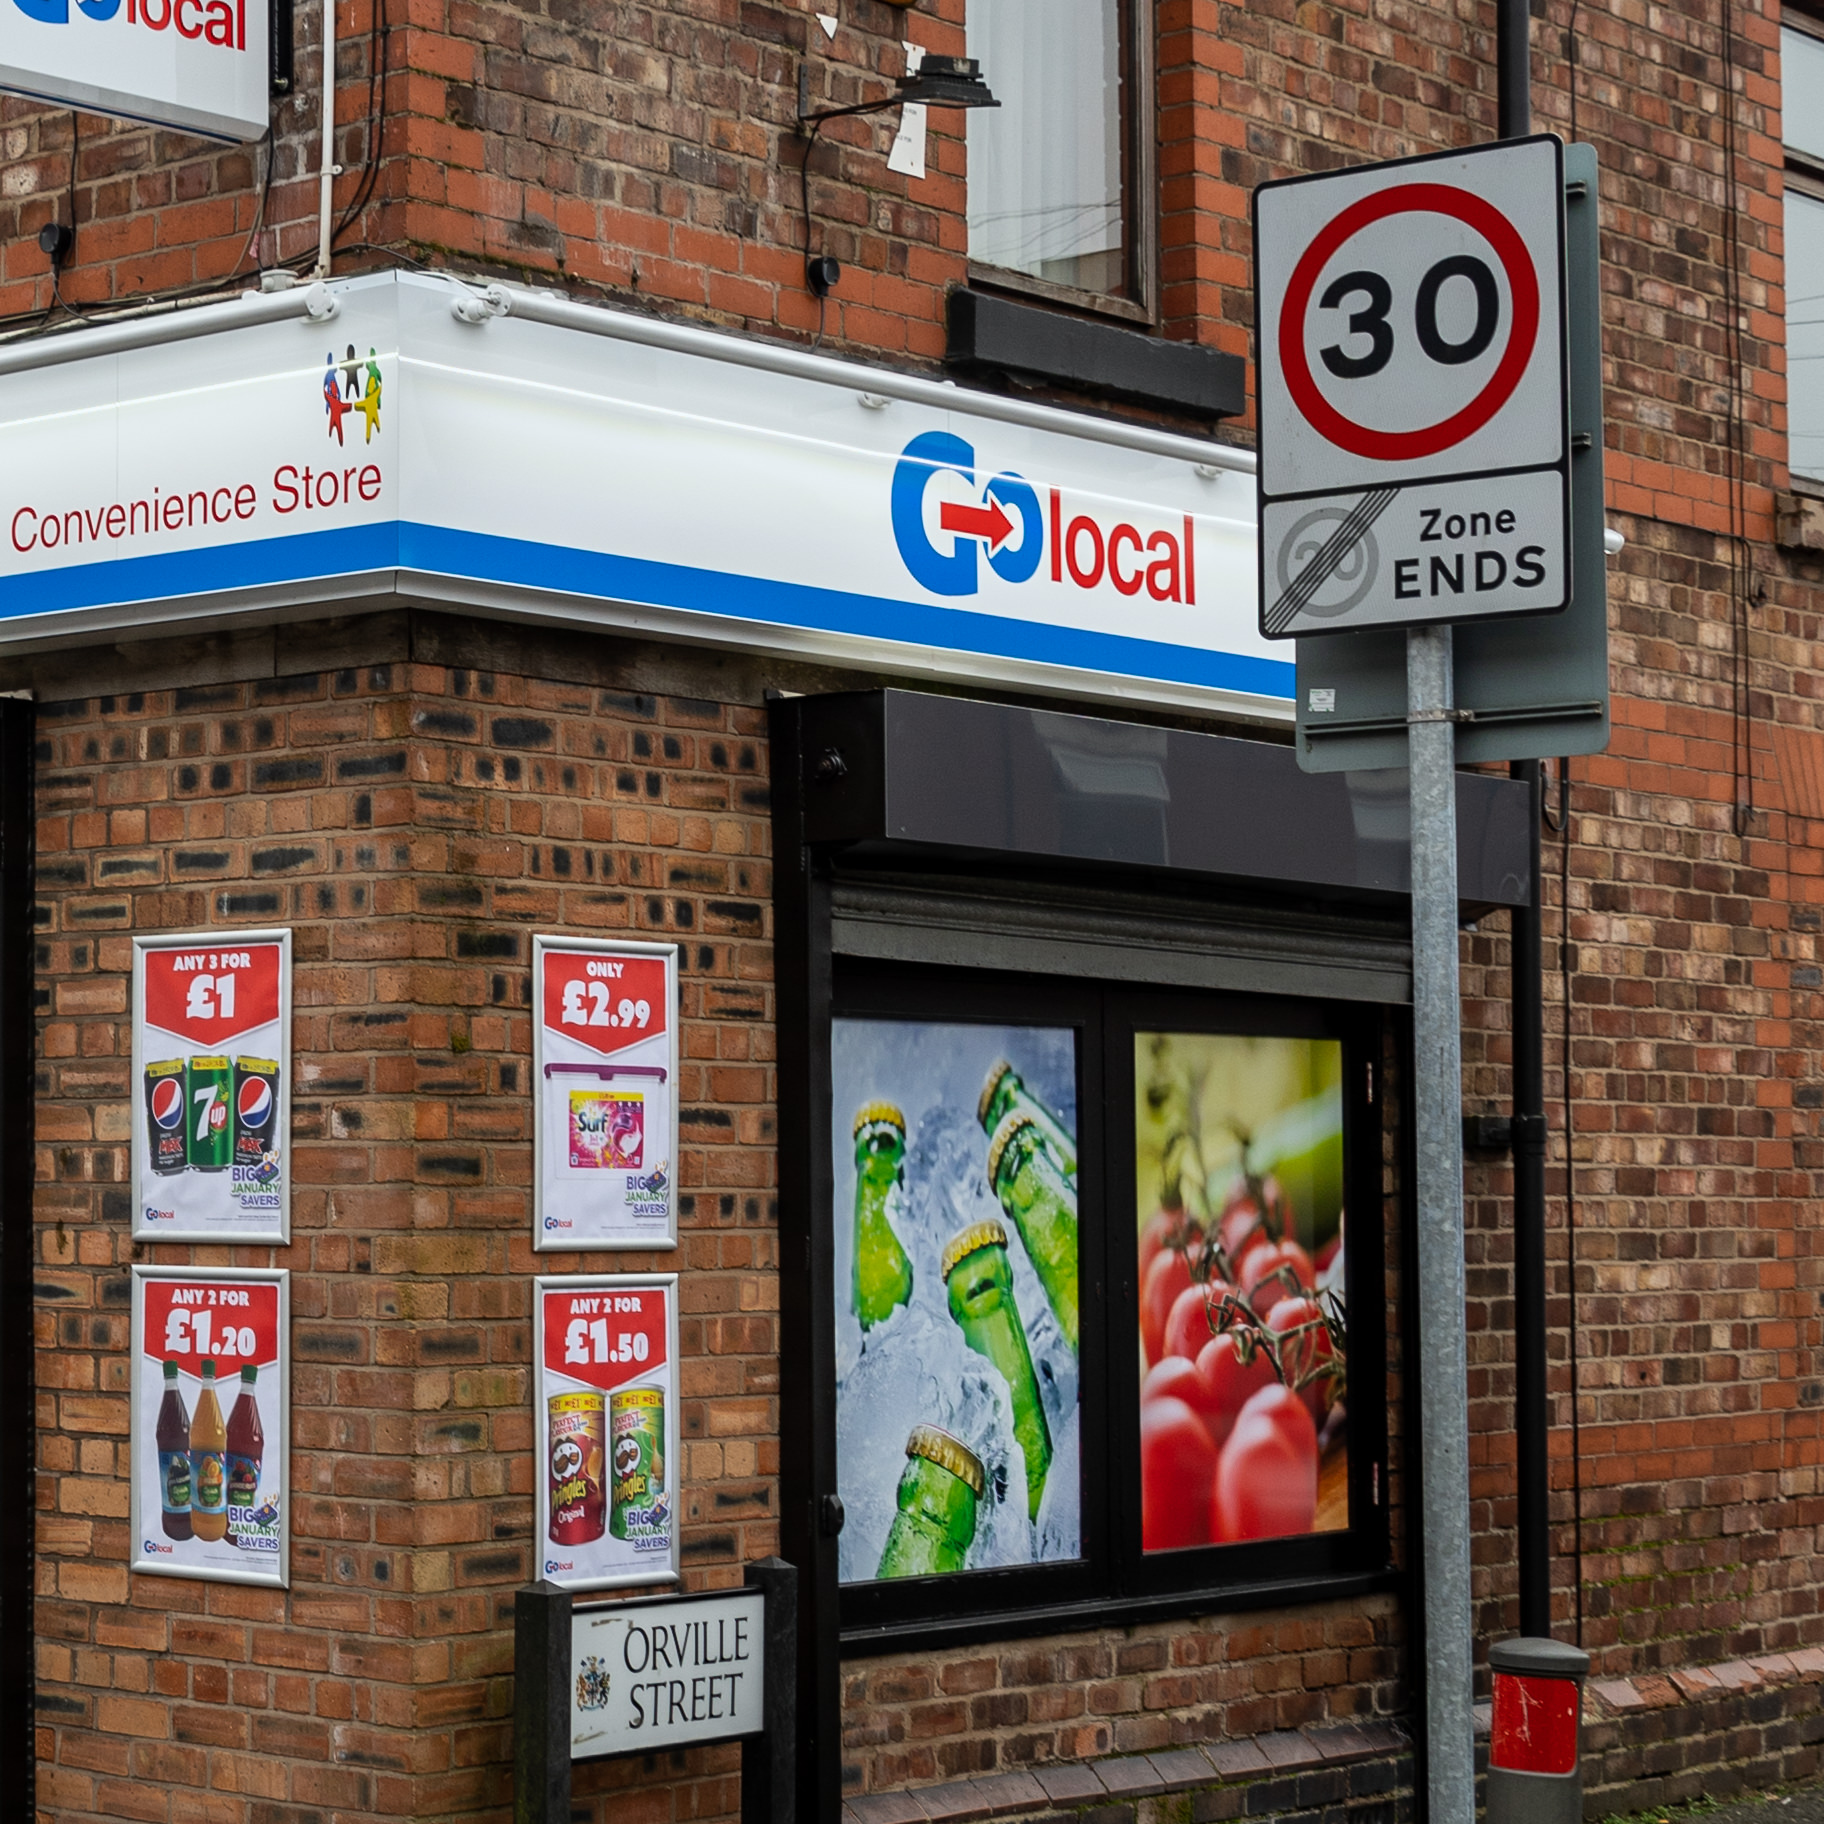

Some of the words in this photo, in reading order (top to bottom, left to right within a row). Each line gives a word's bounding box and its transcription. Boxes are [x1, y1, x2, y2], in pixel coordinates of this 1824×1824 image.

[1317, 254, 1501, 380] 30
[10, 480, 257, 555] Convenience
[272, 461, 382, 515] Store
[1419, 508, 1516, 542] Zone
[1394, 545, 1547, 600] ENDS
[173, 954, 206, 971] ANY
[209, 954, 218, 970] 3
[221, 952, 251, 969] FOR
[586, 961, 624, 978] ONLY
[186, 972, 235, 1019] £1
[562, 979, 651, 1029] £2.99
[578, 1111, 609, 1133] Surf
[232, 1167, 255, 1181] BIG
[231, 1183, 279, 1194] JANUARY
[627, 1176, 647, 1190] BIG
[241, 1195, 279, 1206] SAVERS
[626, 1191, 666, 1202] JANUARY
[633, 1203, 667, 1214] SAVERS
[171, 1288, 204, 1304] ANY
[207, 1290, 217, 1305] 2
[220, 1290, 250, 1306] FOR
[570, 1298, 600, 1314] ANY
[603, 1298, 612, 1313] 2
[614, 1297, 642, 1312] FOR
[165, 1308, 256, 1357] £1.20
[565, 1317, 649, 1364] £1.50
[229, 1507, 253, 1522] BIG
[628, 1511, 649, 1526] BIG
[229, 1523, 278, 1537] JANUARY
[627, 1526, 668, 1537] JANUARY
[238, 1537, 278, 1549] SAVERS
[634, 1537, 668, 1549] SAVERS
[623, 1617, 749, 1674] ORVILLE
[628, 1672, 744, 1729] STREET
